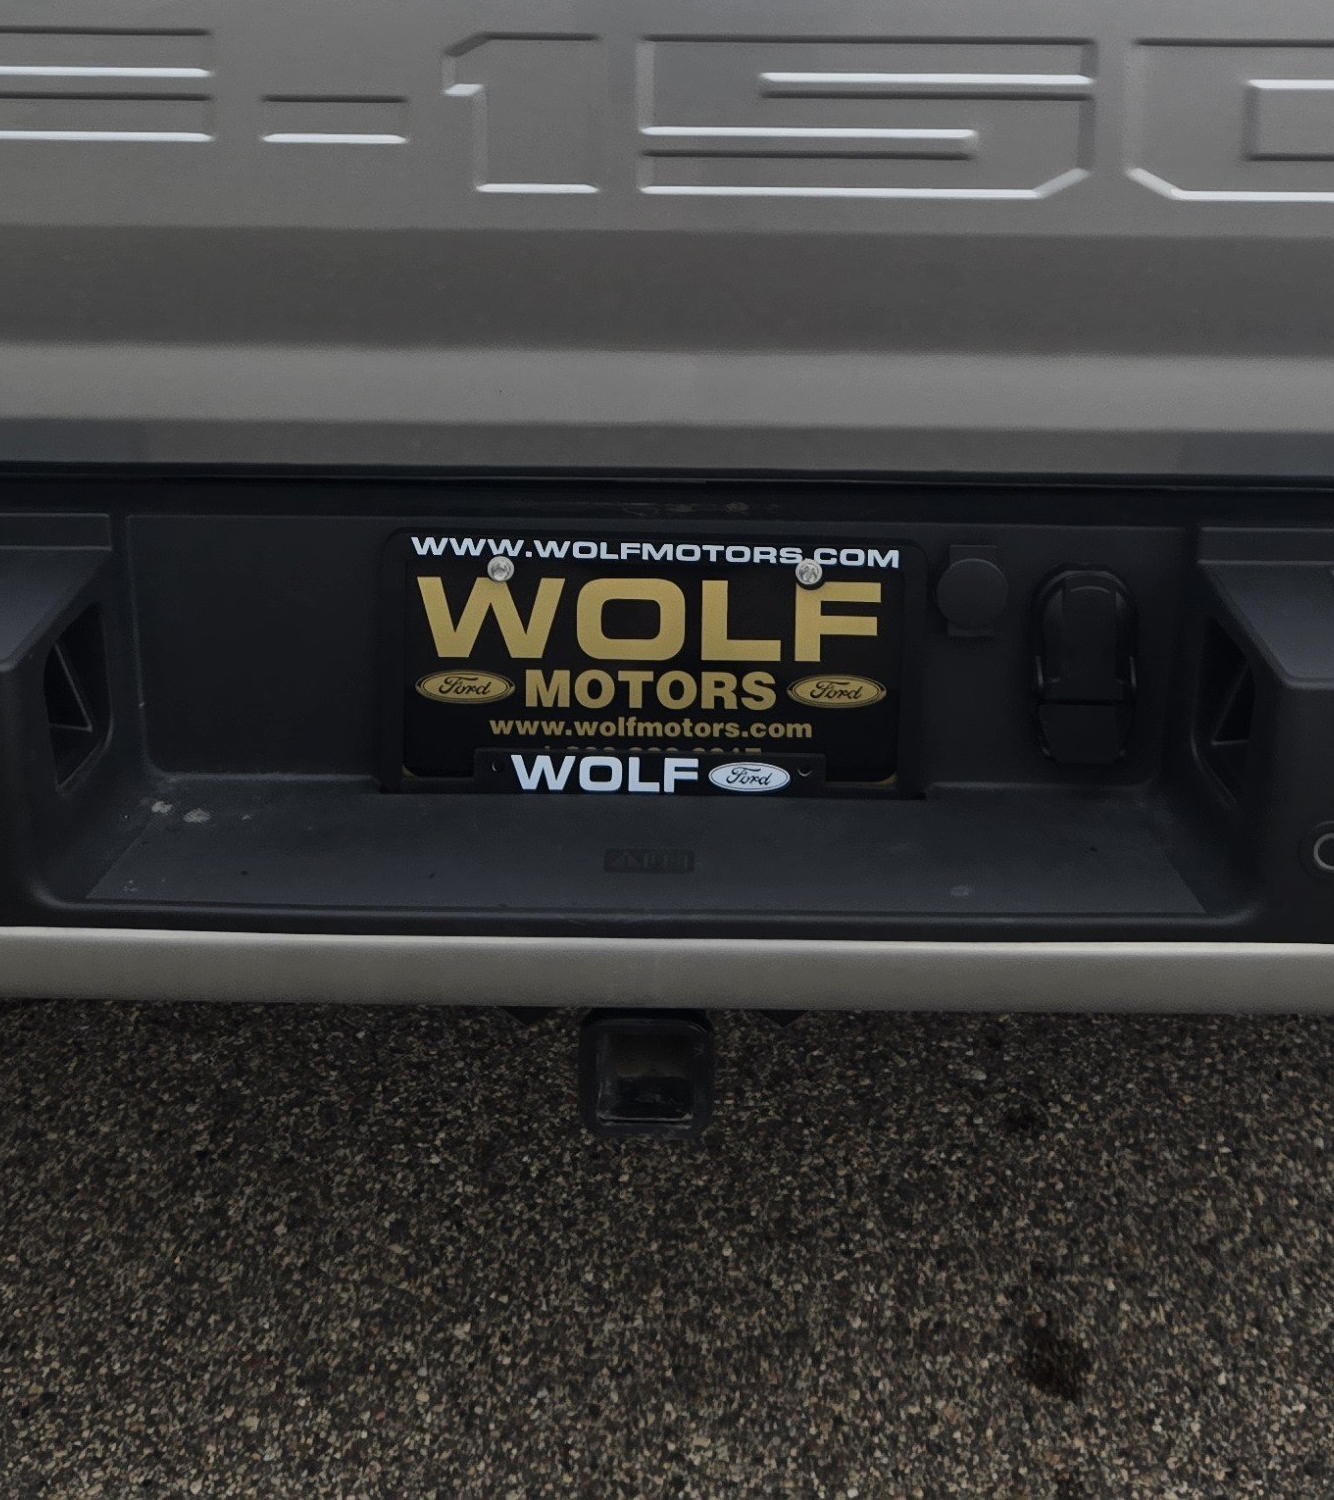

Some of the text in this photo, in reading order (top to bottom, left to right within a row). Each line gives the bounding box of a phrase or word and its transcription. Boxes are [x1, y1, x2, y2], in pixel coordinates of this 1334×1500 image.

[411, 536, 900, 568] WWW.WOLFMOTORSCOM
[417, 576, 882, 661] WOLF
[438, 669, 863, 710] Ford MOTORS Ford
[489, 717, 813, 738] www.wolfmotors.com
[510, 754, 773, 793] WOLF Ford
